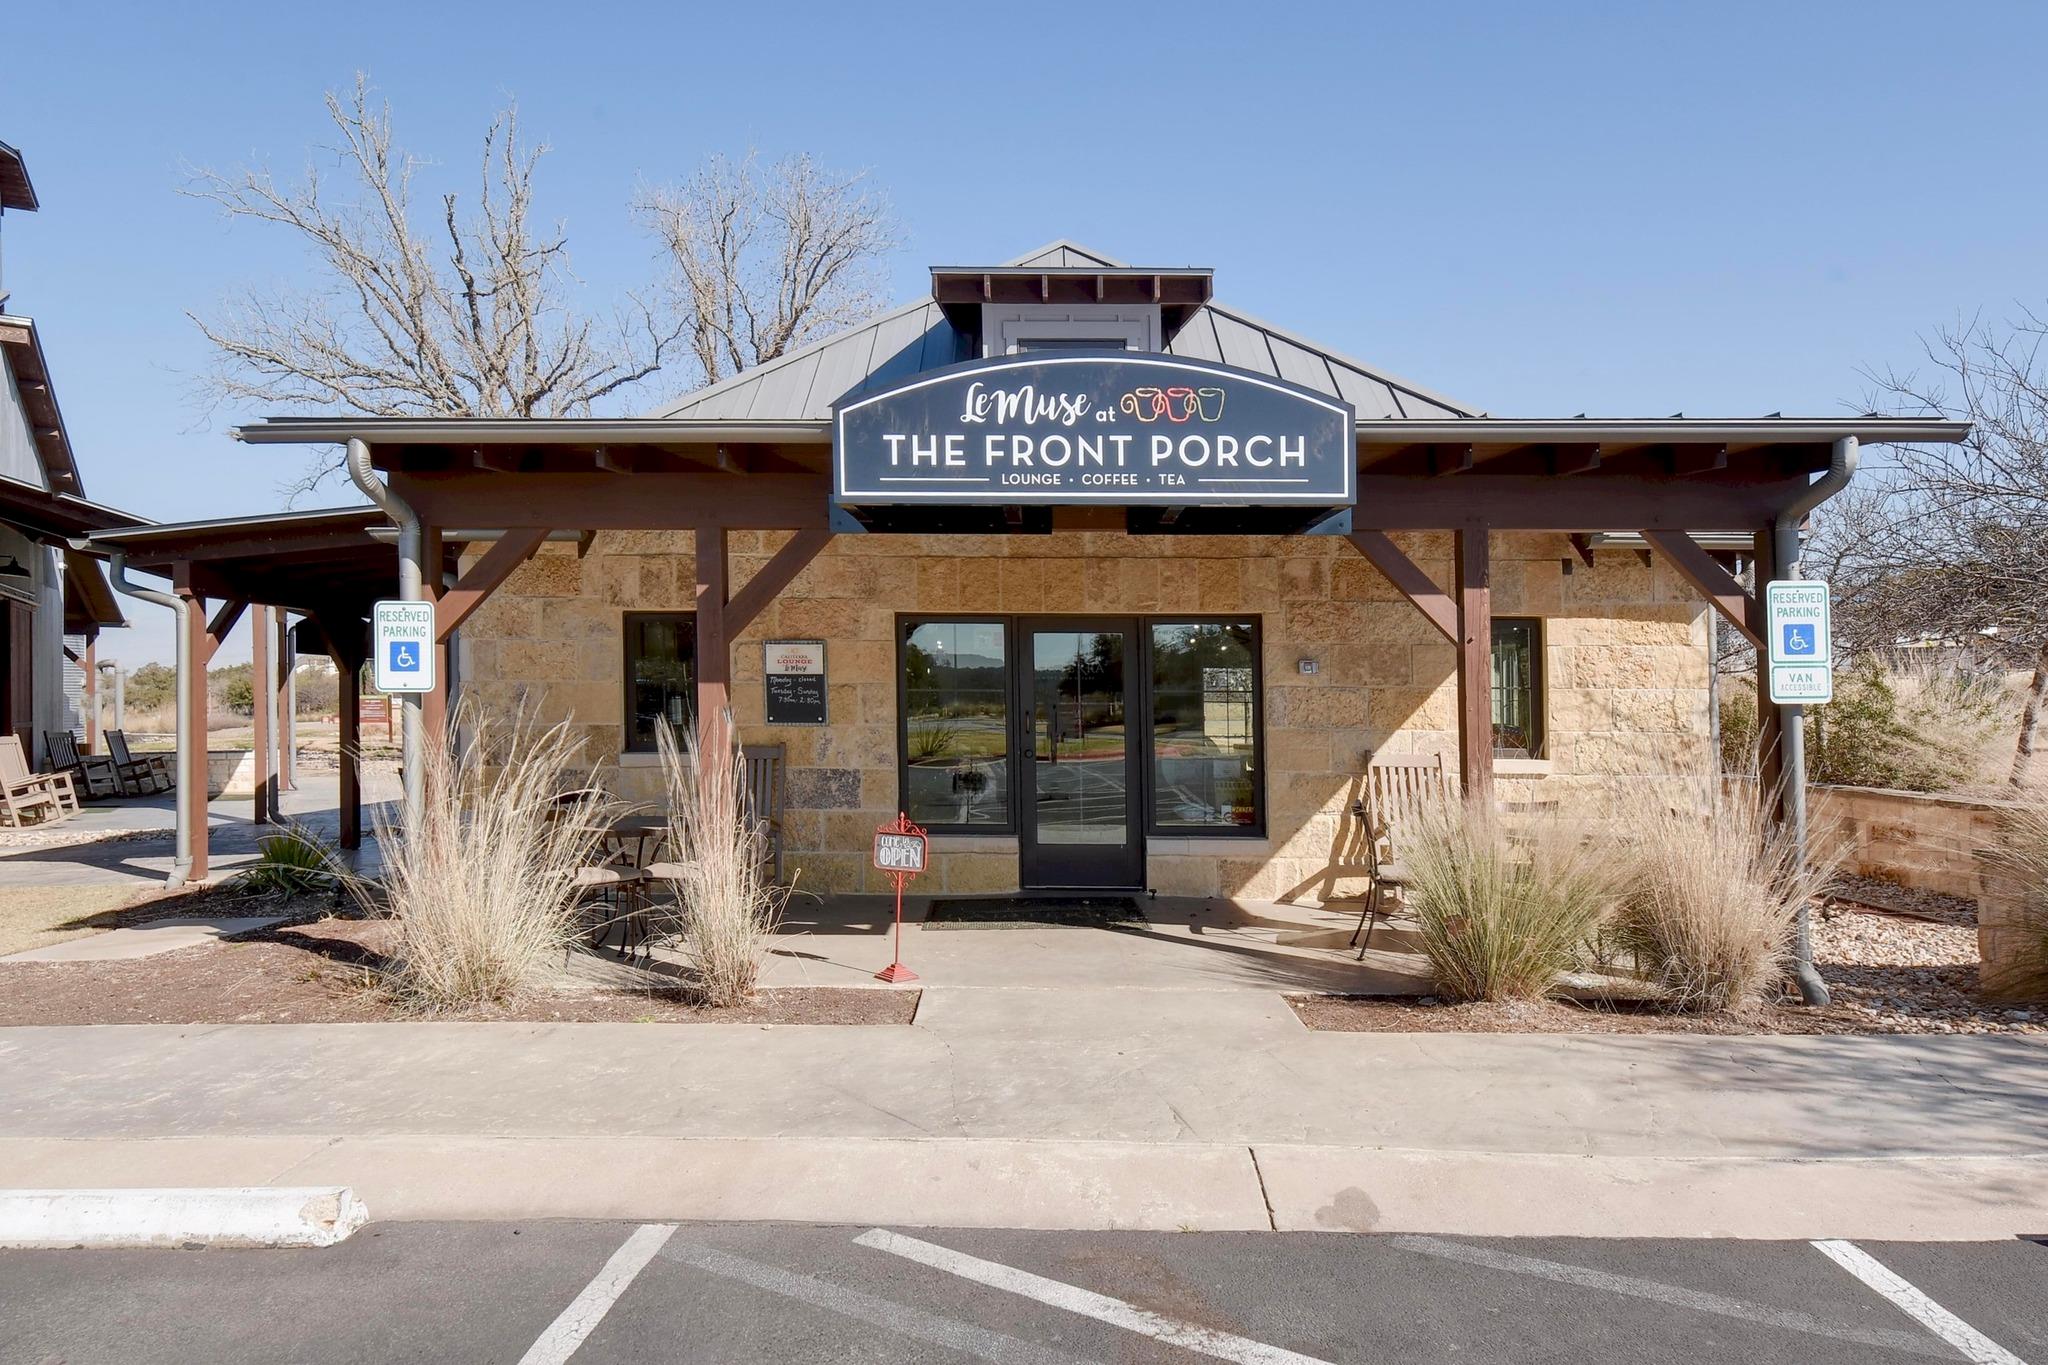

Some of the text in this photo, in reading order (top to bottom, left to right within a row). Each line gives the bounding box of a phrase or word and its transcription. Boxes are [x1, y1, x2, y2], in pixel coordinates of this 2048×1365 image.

[1095, 409, 1116, 423] at
[883, 434, 1306, 467] THE FRONT PORCH
[1001, 473, 1186, 486] LOUNGE COFFEE TEA
[1773, 592, 1823, 604] RESERVED
[379, 611, 430, 622] RESERVED
[1776, 607, 1821, 618] PARKING
[383, 626, 426, 637] PARKING
[1789, 673, 1813, 683] VAN
[1781, 683, 1822, 691] ACCESSIBLE
[880, 847, 921, 868] OPEN
